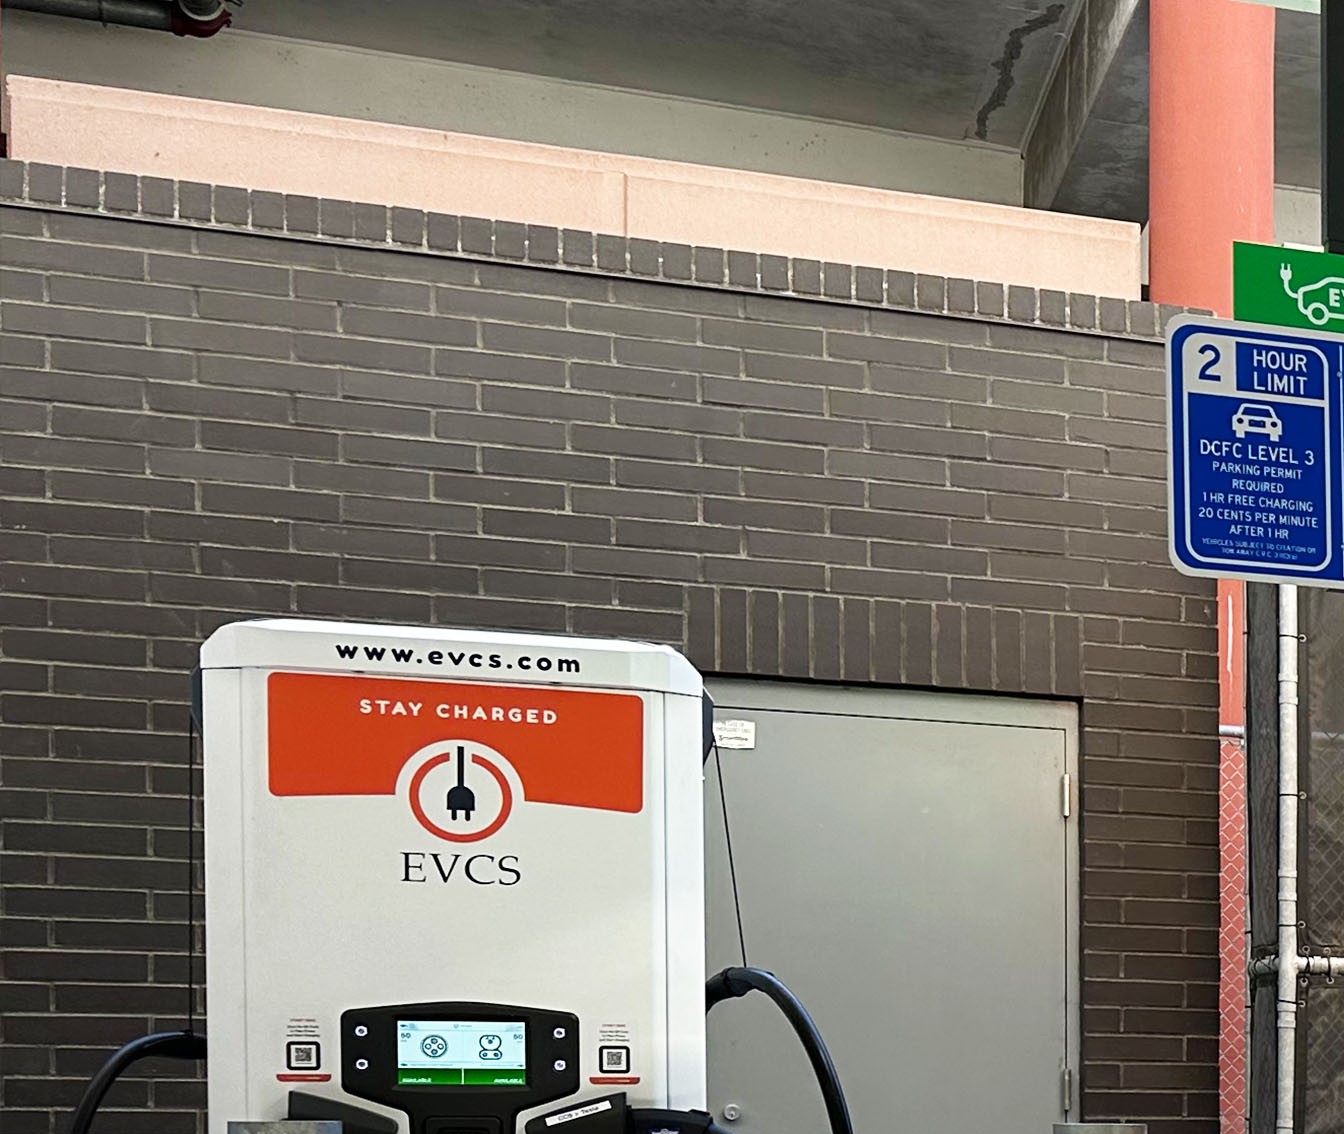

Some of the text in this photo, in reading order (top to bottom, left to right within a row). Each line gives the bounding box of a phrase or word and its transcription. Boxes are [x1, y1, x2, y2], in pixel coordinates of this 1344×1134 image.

[1198, 344, 1221, 382] 2
[1253, 348, 1307, 373] HOUR
[1253, 371, 1307, 395] LIMIT
[1200, 439, 1315, 465] DCFC LEVEL 3
[1212, 461, 1302, 480] PARKING PERMIT
[1232, 478, 1284, 493] REQUIRED
[1203, 492, 1313, 512] 1 HR FREE CHARGING
[1199, 507, 1318, 528] 20 CENTS PER MINUTE
[1229, 525, 1289, 540] AFTER 1 HR
[336, 644, 581, 674] www.evcs.com
[360, 699, 559, 725] STAY CHARGED
[400, 851, 522, 886] EVCS
